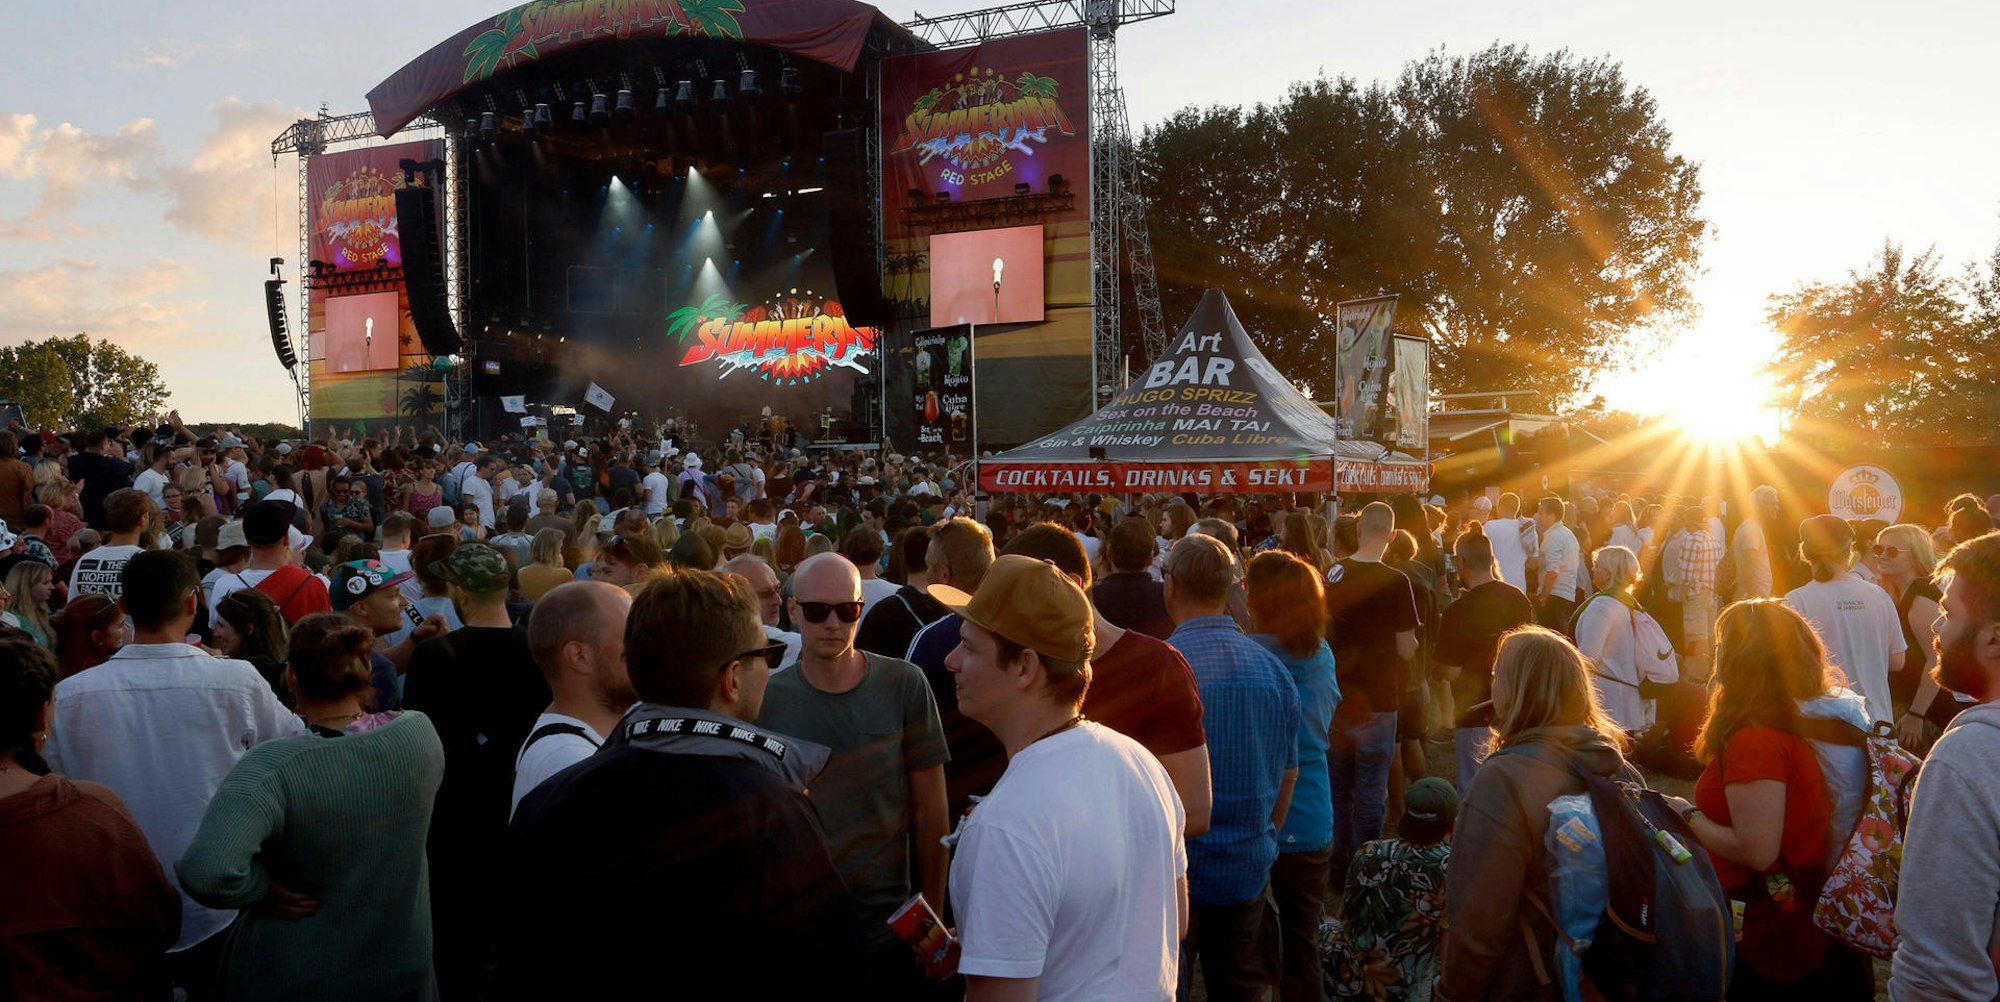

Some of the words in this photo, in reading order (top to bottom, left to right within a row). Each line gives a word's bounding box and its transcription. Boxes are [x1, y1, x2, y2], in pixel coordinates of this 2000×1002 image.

[890, 96, 1076, 155] SUMMERJAM
[940, 168, 965, 186] RED
[970, 159, 1013, 185] STAGE
[341, 247, 359, 263] RED
[361, 242, 390, 263] STAGE
[1176, 331, 1222, 354] Art
[944, 373, 969, 387] Mojito
[1144, 356, 1235, 389] BAR
[942, 394, 968, 404] Cuba
[1112, 388, 1176, 407] HUGO
[1180, 387, 1258, 404] SPRIZZ
[1096, 408, 1129, 421] Sex
[1133, 407, 1158, 418] on
[1161, 403, 1192, 416] the
[1196, 403, 1258, 418] Beach
[1071, 419, 1167, 436] Caipirinha
[1172, 418, 1222, 431] MAI
[1230, 420, 1271, 432] TAI
[918, 433, 944, 443] Beach
[1040, 438, 1069, 449] Gin
[1072, 436, 1086, 447] &
[1089, 433, 1165, 447] Whiskey
[1171, 433, 1227, 445] Cuba
[1232, 433, 1289, 445] Libre
[995, 469, 1116, 488] COCKTAILS,
[1125, 469, 1212, 486] DRINKS
[1220, 468, 1237, 486] &
[1248, 468, 1310, 486] SEKT
[106, 561, 128, 570] THE
[82, 573, 118, 582] NORTH
[80, 585, 104, 594] FACE
[632, 720, 651, 736] NIKE
[657, 719, 684, 732] NIKE
[692, 720, 722, 735] NIKE
[730, 727, 758, 743] NIKE
[763, 738, 786, 757] NIKE
